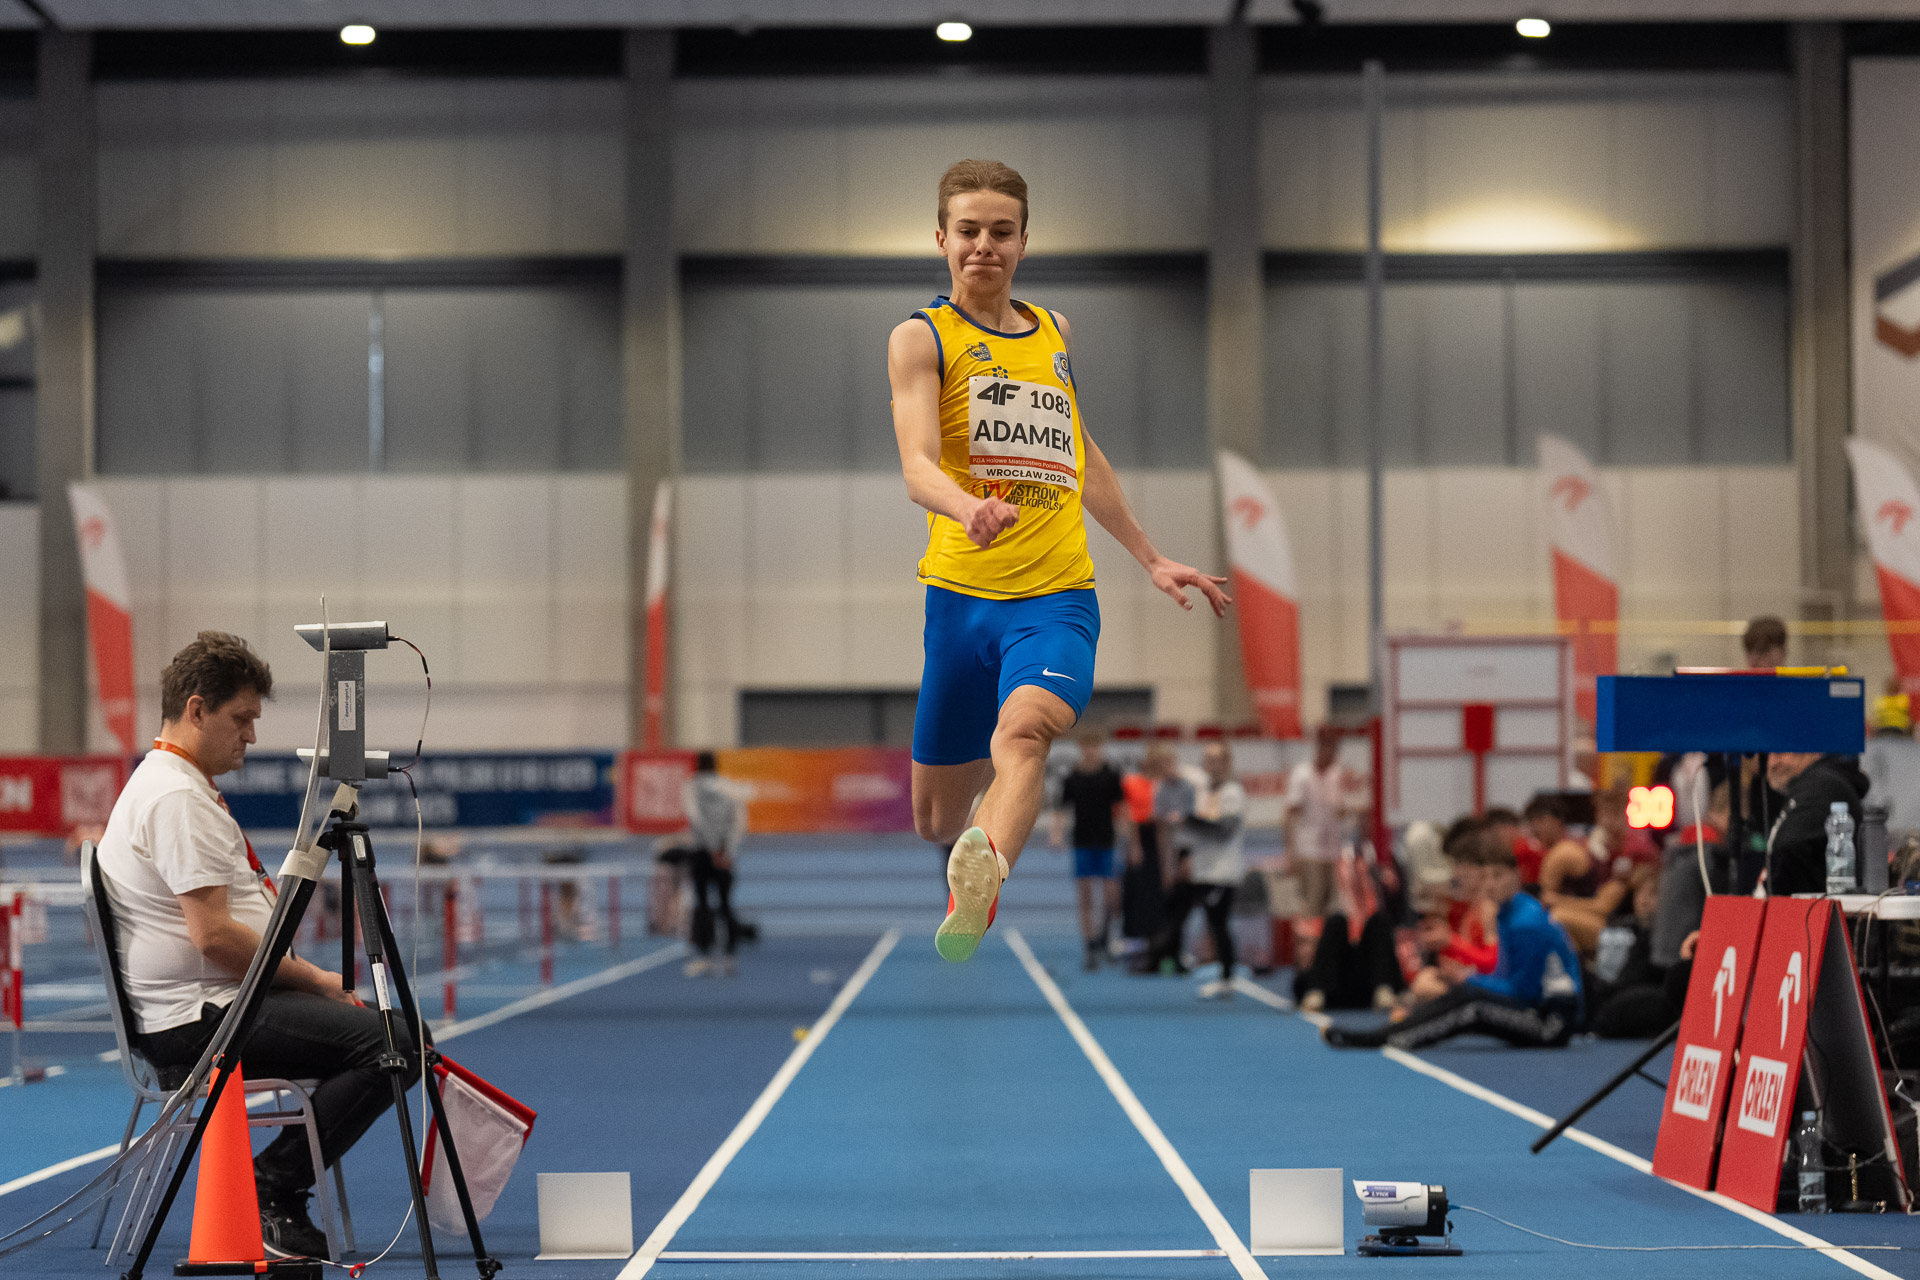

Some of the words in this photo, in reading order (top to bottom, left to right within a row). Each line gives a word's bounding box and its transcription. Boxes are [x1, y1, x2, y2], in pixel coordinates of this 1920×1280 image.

[977, 382, 1021, 406] 4F
[1030, 390, 1071, 419] 1083
[974, 419, 1073, 457] ADAMEK
[986, 468, 1043, 480] WROCŁAW
[1044, 473, 1067, 484] 2025
[1008, 458, 1042, 467] Mistrzostwa
[1010, 484, 1060, 502] OSTRÓW
[1678, 1056, 1717, 1106] ORLEN
[1745, 1068, 1784, 1124] ORLEN
